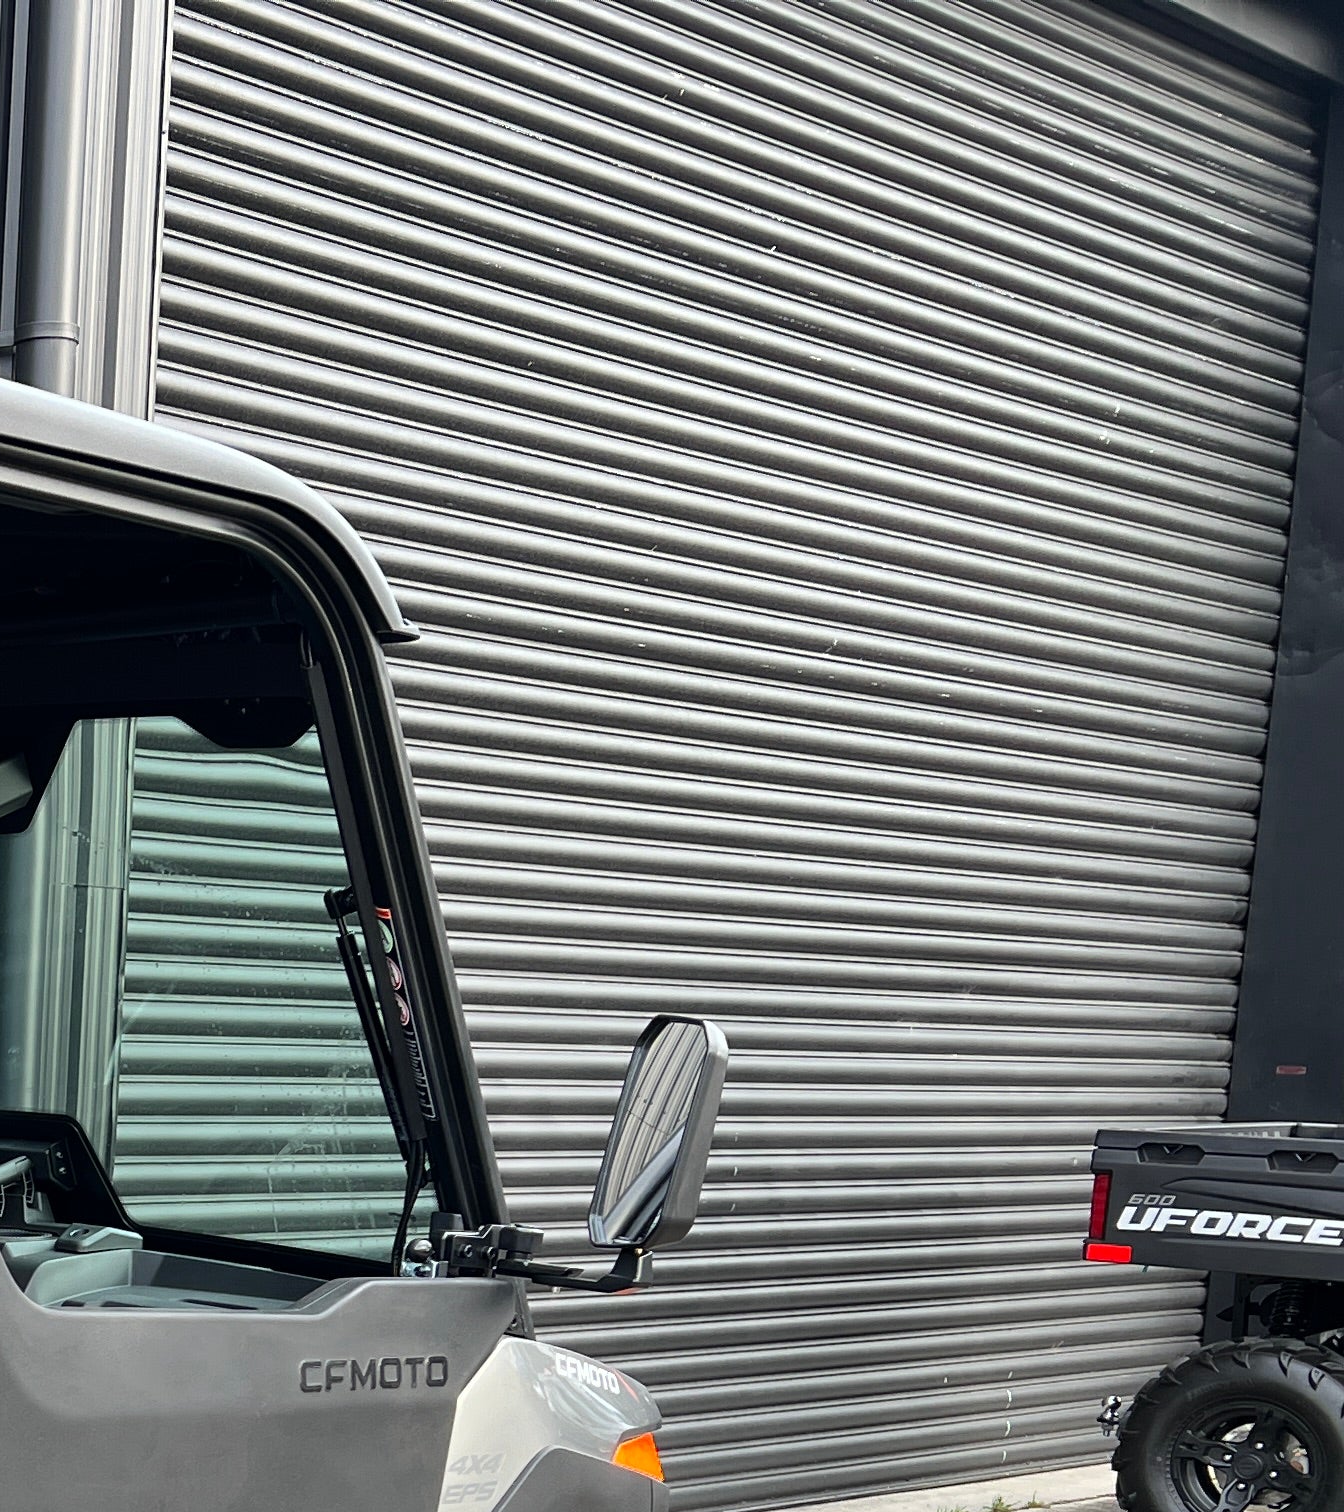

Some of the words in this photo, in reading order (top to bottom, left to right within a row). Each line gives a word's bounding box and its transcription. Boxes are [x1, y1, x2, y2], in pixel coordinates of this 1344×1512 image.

[1127, 1193, 1177, 1206] 600
[1116, 1206, 1344, 1247] UFORCE
[299, 1355, 449, 1393] CFMOTO
[555, 1353, 621, 1395] CFMOTO
[450, 1453, 505, 1475] 4X4
[441, 1481, 498, 1505] EPS
